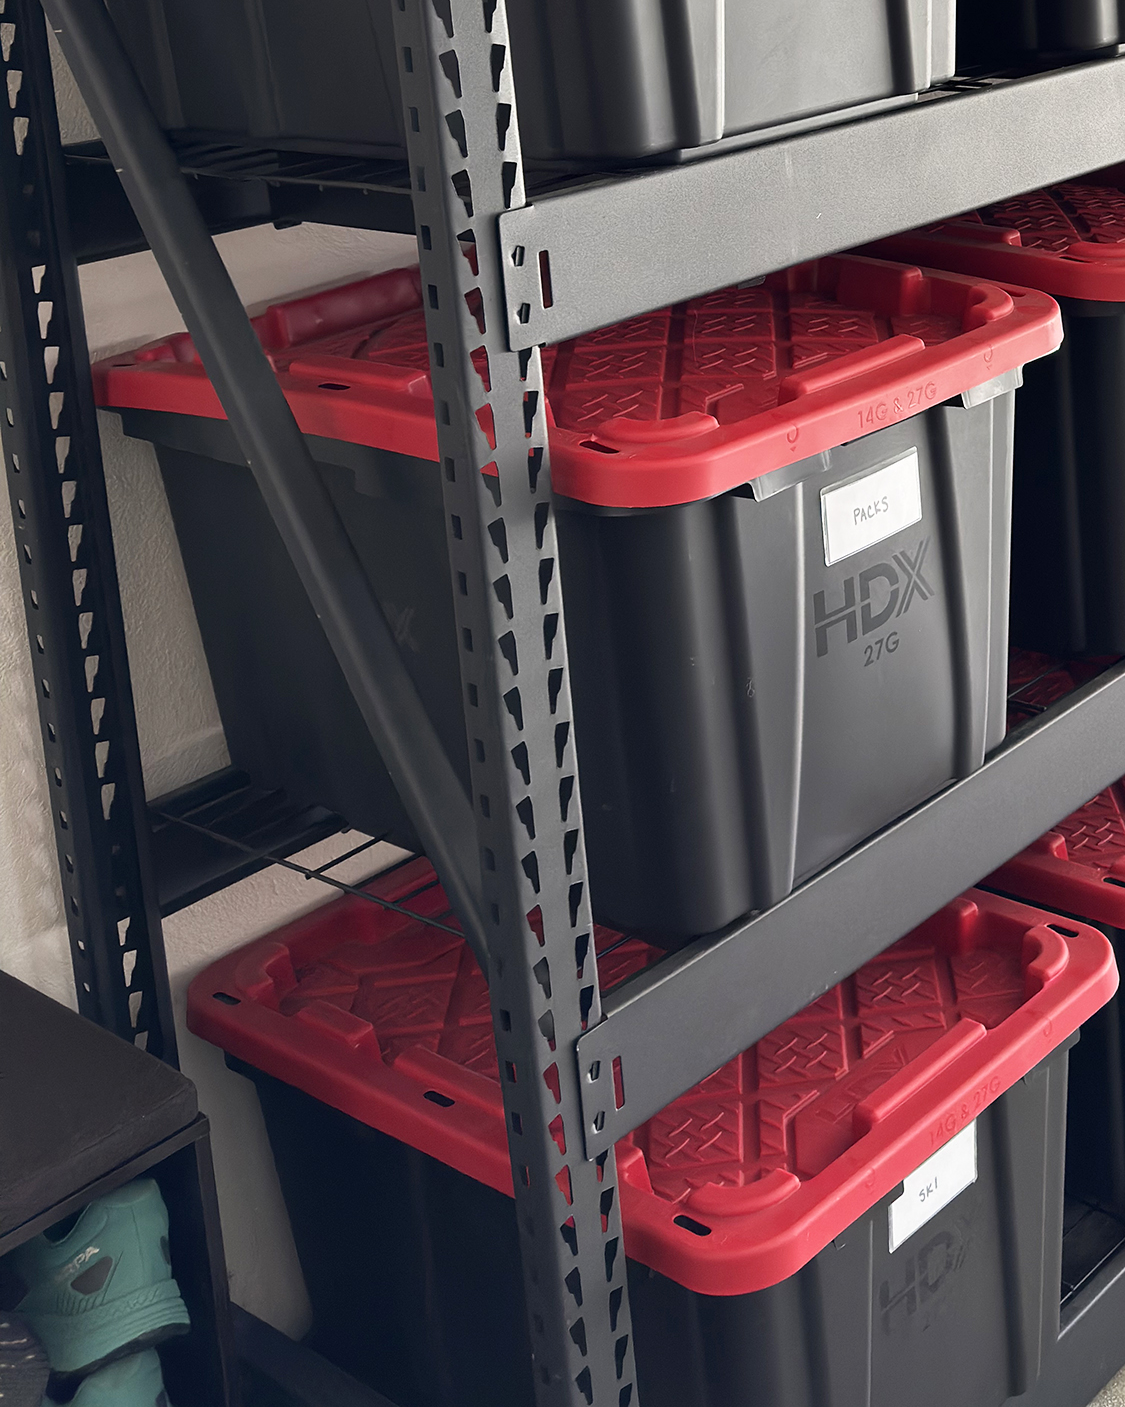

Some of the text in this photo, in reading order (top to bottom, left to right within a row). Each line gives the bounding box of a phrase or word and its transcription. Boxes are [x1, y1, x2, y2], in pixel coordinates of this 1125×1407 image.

[857, 381, 937, 429] 14G & 27G
[853, 496, 889, 525] PACKS
[812, 535, 935, 658] HDX
[864, 631, 900, 667] 27G
[929, 1075, 1001, 1147] 14G & 27G
[918, 1176, 938, 1203] SKI
